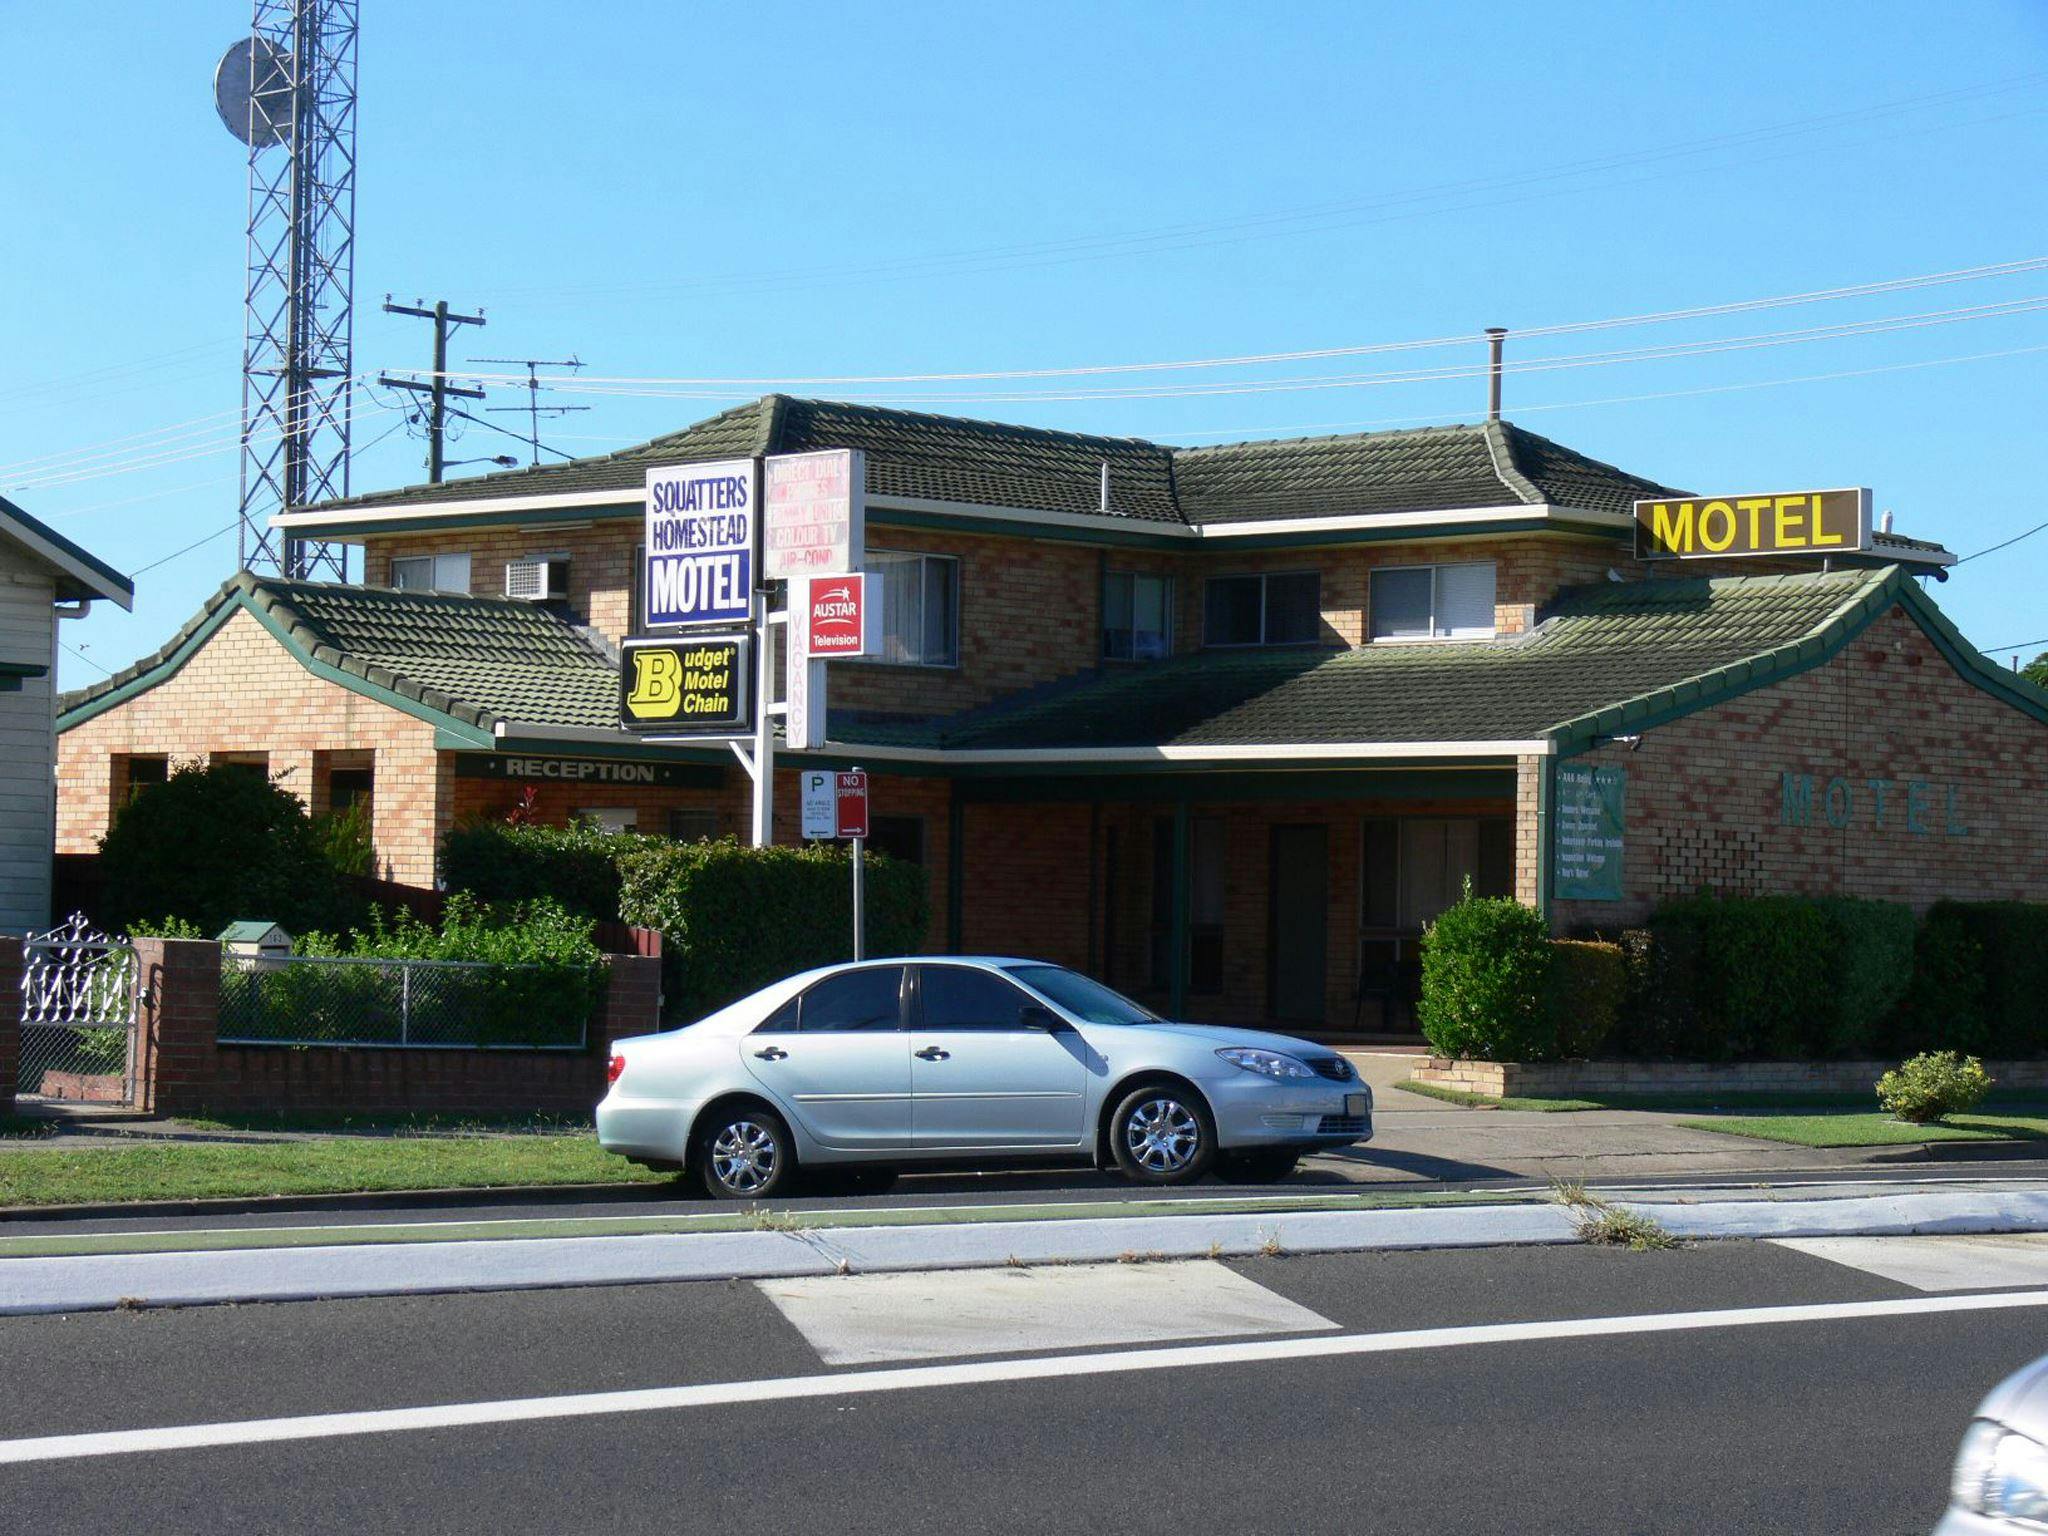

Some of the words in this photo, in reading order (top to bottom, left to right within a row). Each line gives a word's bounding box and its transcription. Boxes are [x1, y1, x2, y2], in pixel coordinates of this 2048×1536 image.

[653, 475, 748, 514] SQUATTERS
[653, 514, 748, 551] HOMESTEAD
[1652, 494, 1843, 554] MOTEL
[775, 525, 819, 548] COLOUR
[652, 554, 748, 615] MOTEL
[813, 602, 857, 617] AUSTAR
[813, 633, 858, 647] Television
[684, 669, 729, 690] Motel
[792, 612, 806, 744] VACANCY
[683, 692, 729, 713] Chain
[506, 758, 655, 782] RECEPTION
[842, 775, 859, 786] NO
[811, 776, 824, 792] P
[1781, 771, 1969, 836] MOTEL
